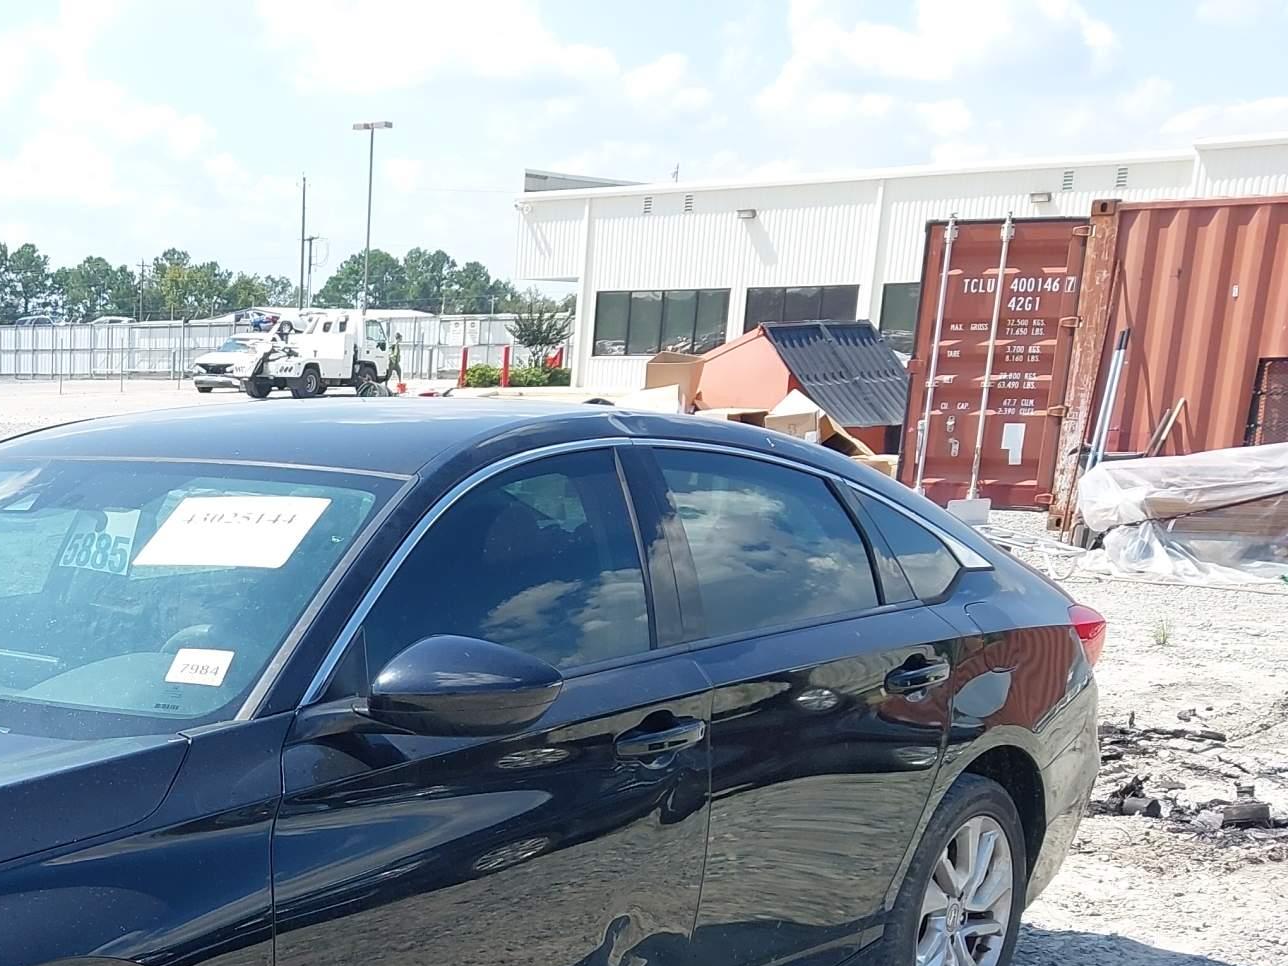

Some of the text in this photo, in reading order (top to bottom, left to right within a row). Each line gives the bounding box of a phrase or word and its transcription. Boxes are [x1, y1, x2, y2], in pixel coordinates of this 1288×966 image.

[963, 278, 996, 293] TCLU
[1009, 277, 1060, 293] 400146
[1007, 296, 1040, 311] 42G1
[969, 323, 989, 331] GROSS
[63, 531, 131, 574] 5885
[180, 663, 220, 677] 7984
